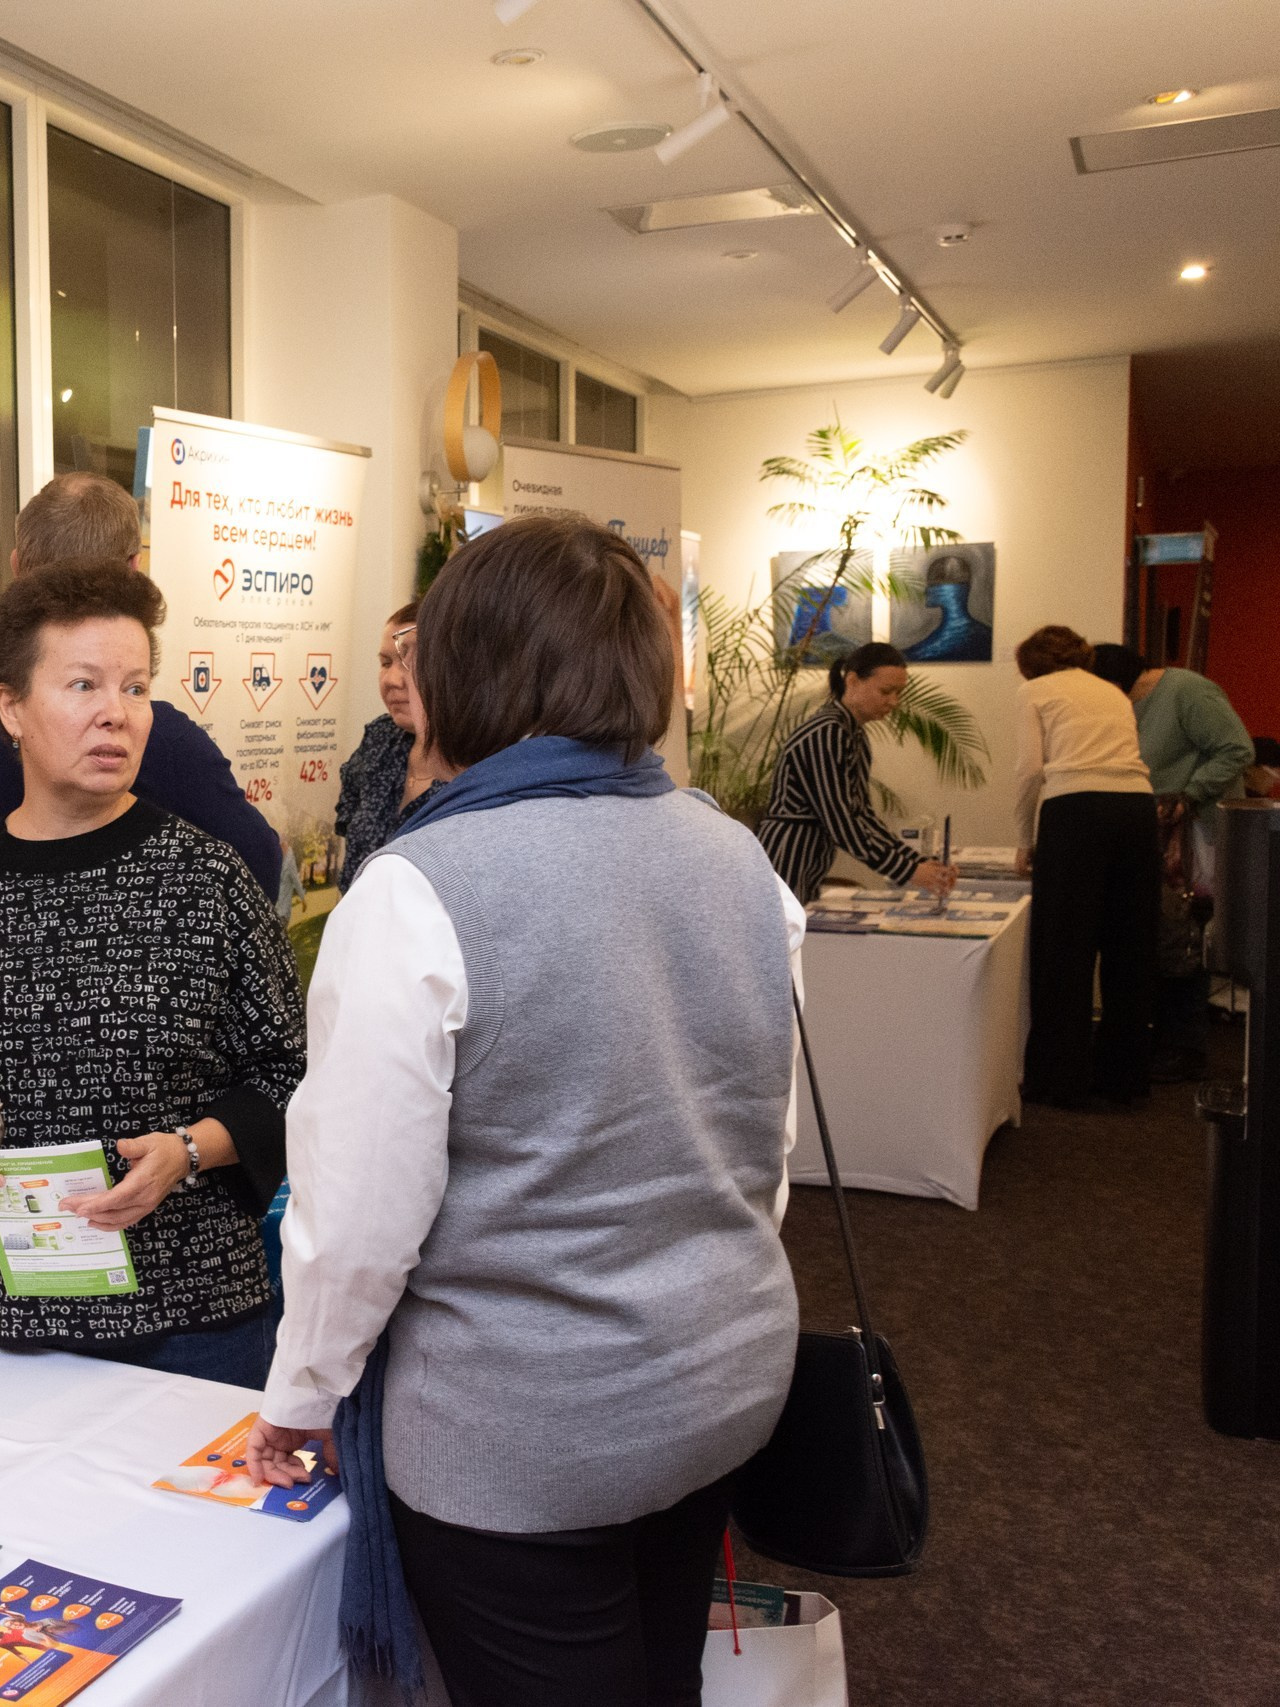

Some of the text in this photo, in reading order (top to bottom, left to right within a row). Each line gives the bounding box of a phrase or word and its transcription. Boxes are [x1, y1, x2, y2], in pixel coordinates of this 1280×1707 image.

[170, 480, 354, 527] Для тех, кто любит жизнь
[213, 524, 317, 551] всем сердцем!
[242, 568, 314, 595] ЭСПИРО
[300, 759, 328, 783] 42%
